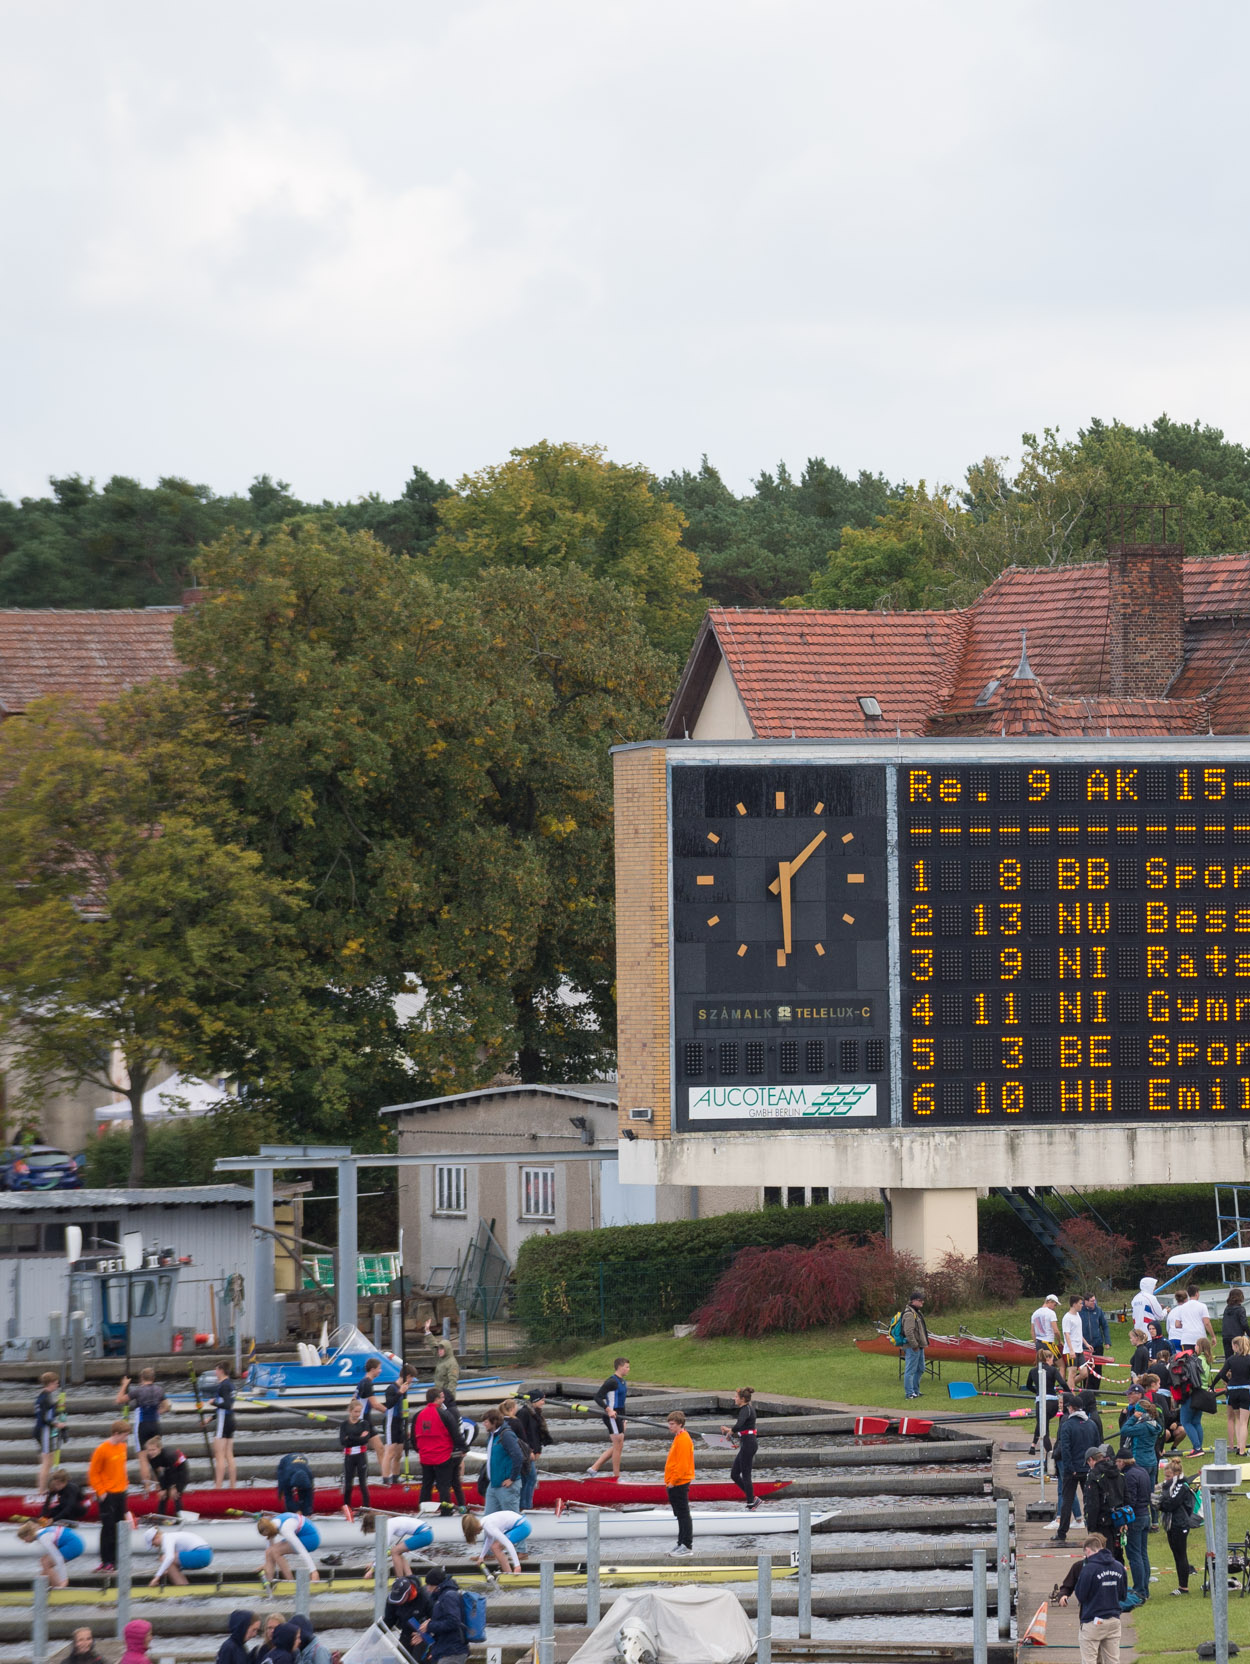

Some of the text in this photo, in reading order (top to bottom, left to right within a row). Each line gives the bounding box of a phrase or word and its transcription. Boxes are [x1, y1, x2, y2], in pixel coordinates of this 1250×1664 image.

[909, 770, 987, 802] Re.
[1028, 769, 1051, 801] 9
[1086, 768, 1138, 801] AK
[914, 859, 929, 892] 1
[999, 858, 1022, 891] 8
[1057, 857, 1110, 890] BB
[910, 904, 933, 937] 2
[974, 903, 1022, 936] 13
[1058, 902, 1110, 935] NW
[911, 949, 934, 981] 3
[999, 947, 1022, 980] 9
[1058, 946, 1107, 979] NI
[796, 1006, 870, 1018] TELELUX-C
[911, 993, 934, 1026] 4
[975, 992, 1019, 1025] 11
[1059, 990, 1107, 1024] NI
[912, 1038, 935, 1071] 5
[1001, 1036, 1024, 1069] 3
[1060, 1035, 1112, 1068] BE
[693, 1087, 806, 1107] AUCOTEAM
[749, 1107, 800, 1118] GMBH BERLIN
[912, 1082, 936, 1115] 6
[976, 1081, 1024, 1114] 10
[1060, 1079, 1113, 1112] HH
[338, 1357, 353, 1377] 2
